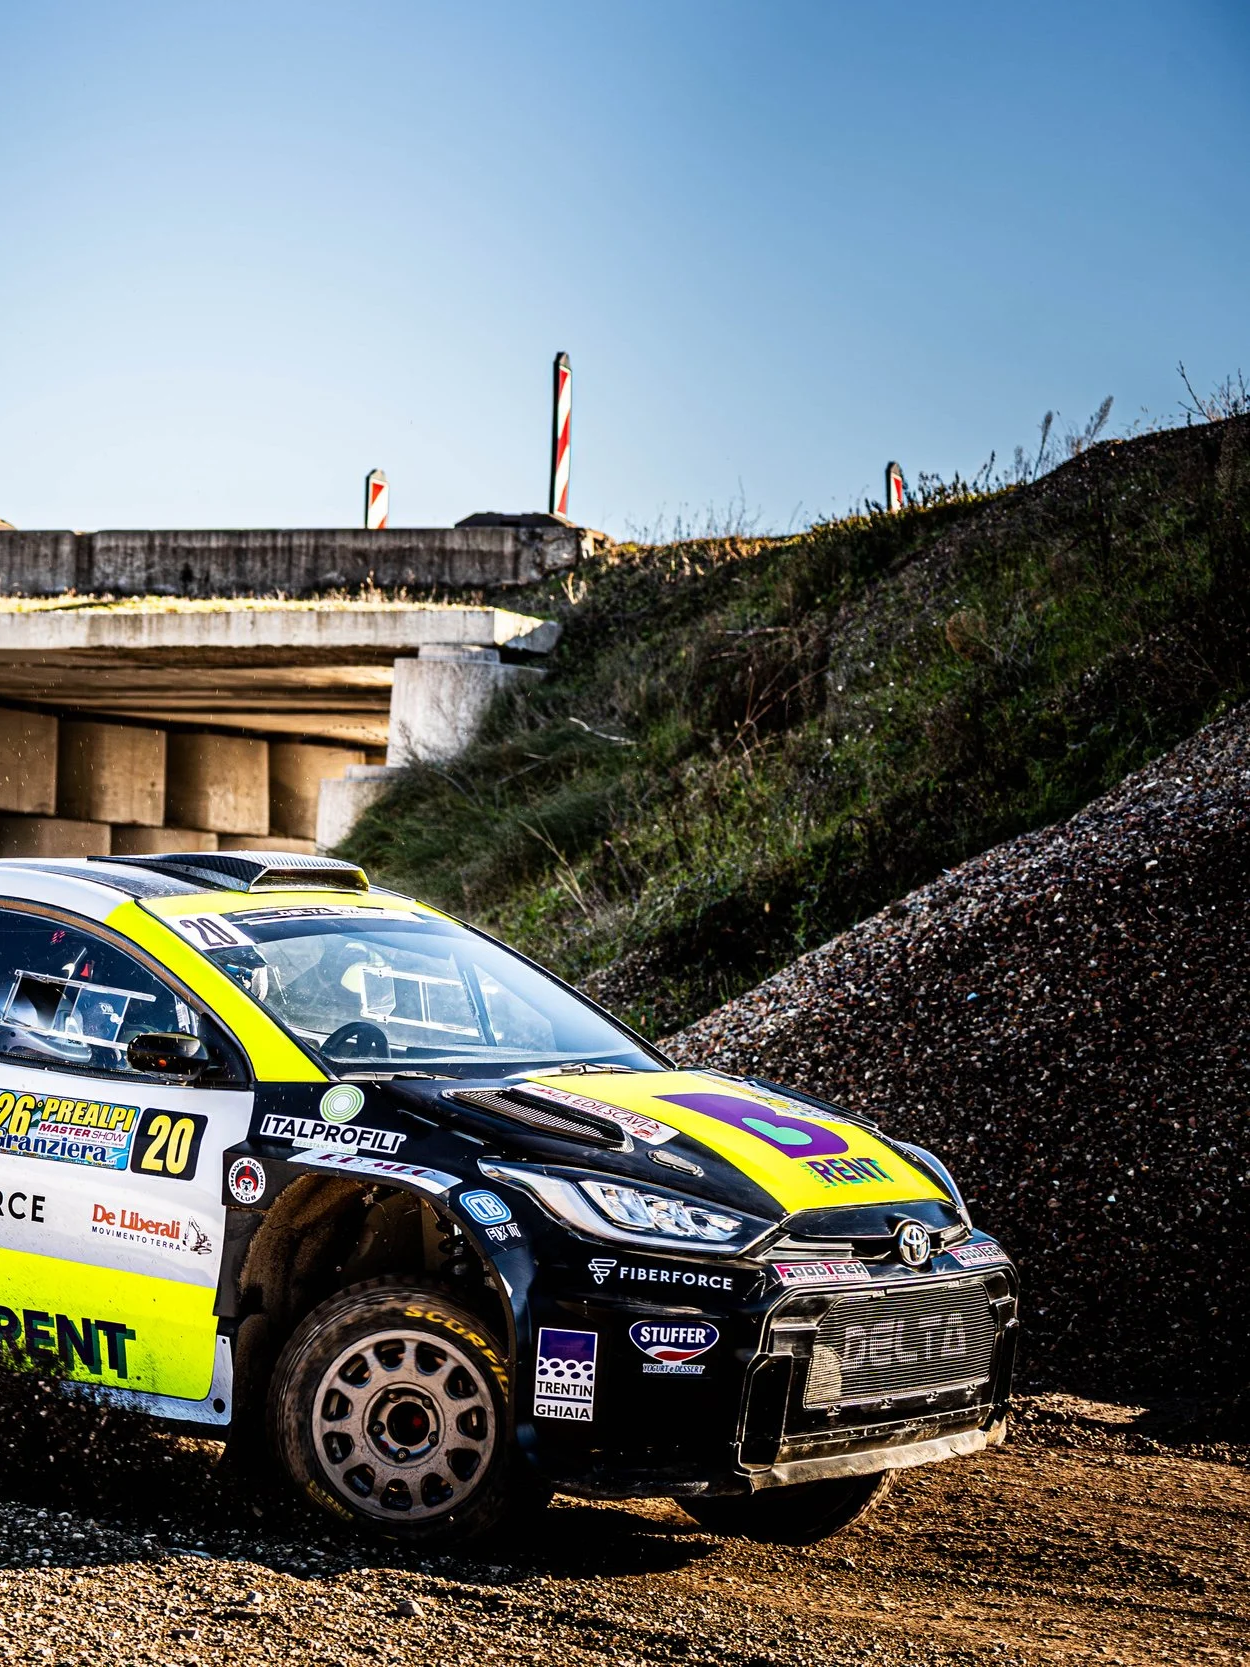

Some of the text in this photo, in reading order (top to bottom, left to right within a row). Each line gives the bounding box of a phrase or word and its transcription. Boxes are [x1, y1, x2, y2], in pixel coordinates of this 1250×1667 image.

[180, 918, 238, 946] 20
[41, 1098, 136, 1131] PREALPI
[572, 1096, 646, 1127] EDILSCAVI
[39, 1123, 91, 1138] MASTER
[91, 1130, 126, 1142] SHOW
[141, 1115, 194, 1174] 20
[262, 1116, 401, 1151] ITALPROFILI
[806, 1158, 894, 1186] RENT
[235, 1192, 256, 1201] CLUB
[92, 1204, 180, 1239] De Liberali
[92, 1226, 180, 1251] MOVIMENTO TERRA
[620, 1266, 733, 1290] FIBERFORCE
[640, 1326, 706, 1343] STUFFER
[643, 1363, 669, 1373] YOGURT
[674, 1364, 705, 1374] DESSERT
[537, 1381, 592, 1397] TRENTIN
[535, 1404, 590, 1419] GHIAIA
